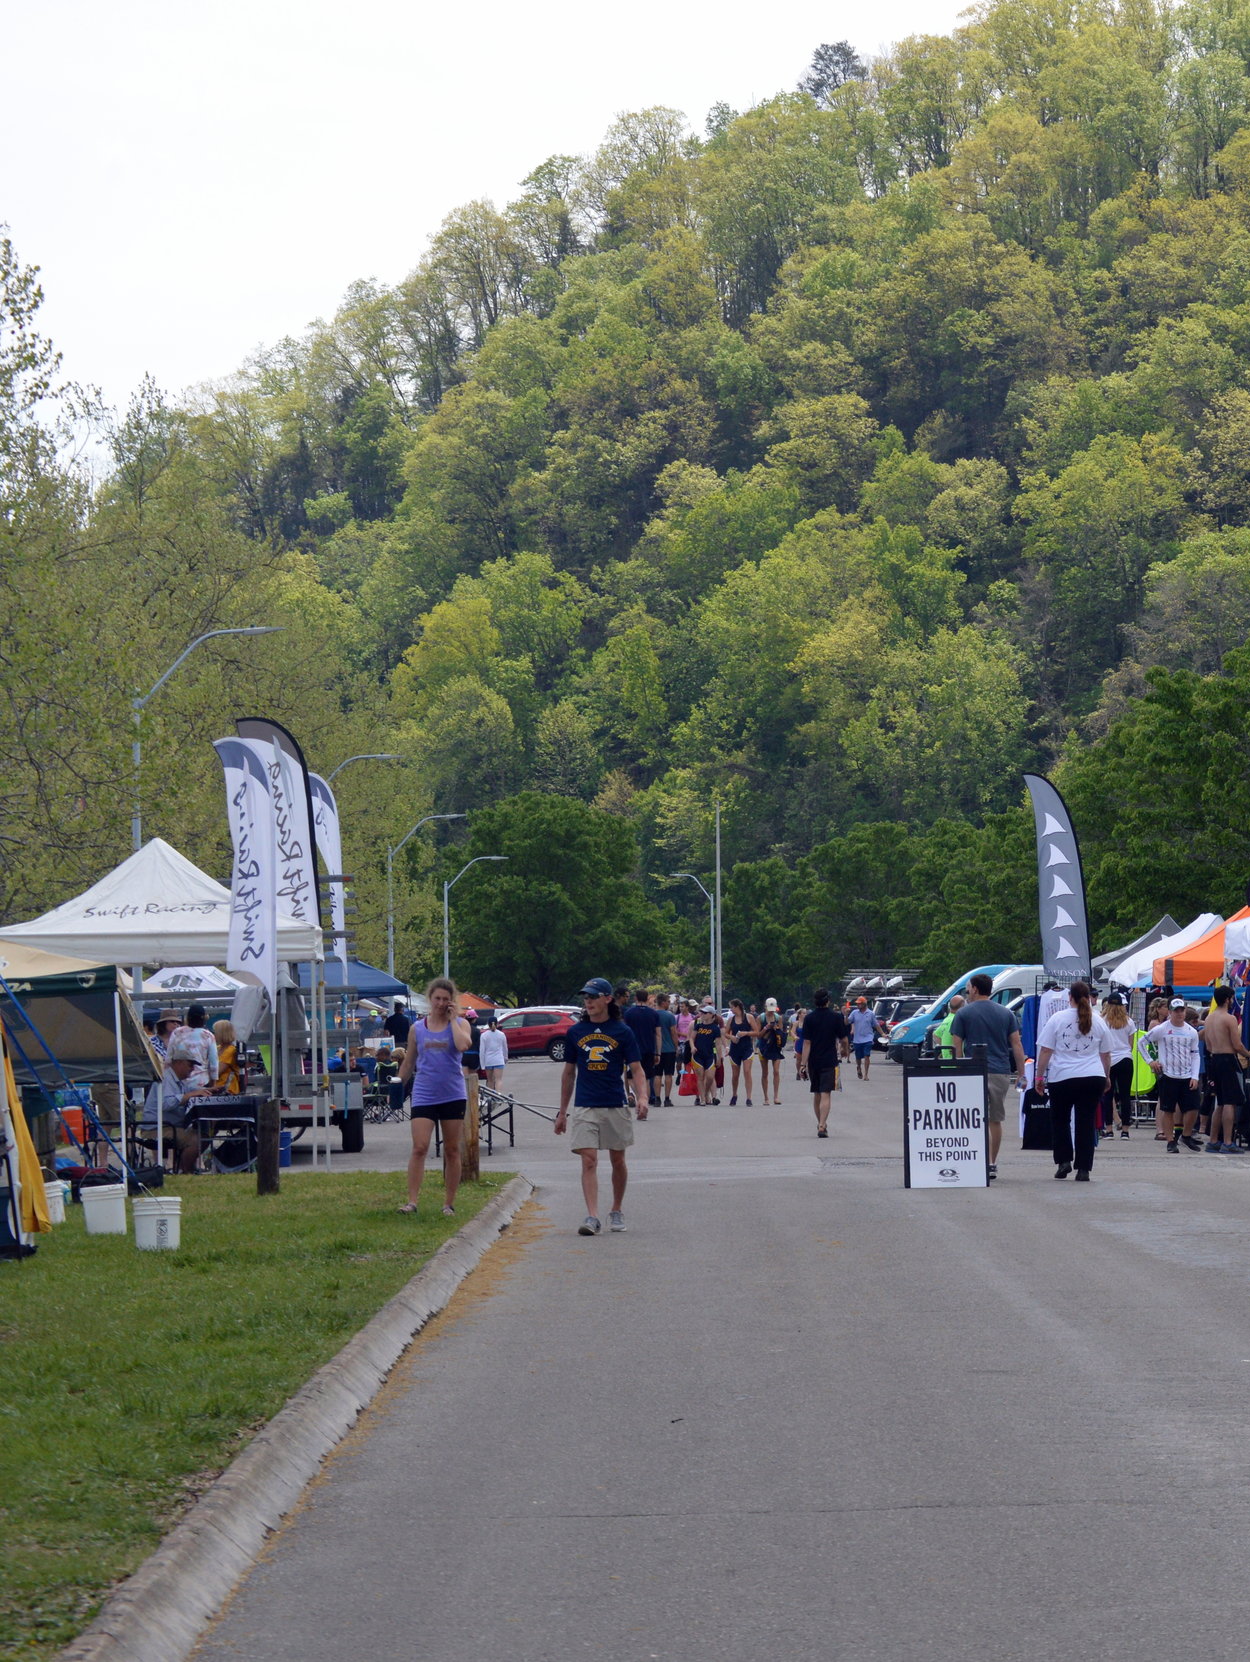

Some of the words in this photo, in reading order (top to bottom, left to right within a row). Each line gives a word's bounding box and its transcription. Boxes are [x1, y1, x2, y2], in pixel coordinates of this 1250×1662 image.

[83, 904, 138, 918] Swift
[145, 903, 217, 914] Racing
[936, 1081, 956, 1104] NO
[913, 1107, 981, 1130] PARKING
[926, 1137, 969, 1148] BEYOND
[918, 1151, 942, 1162] THIS
[946, 1150, 978, 1161] POINT
